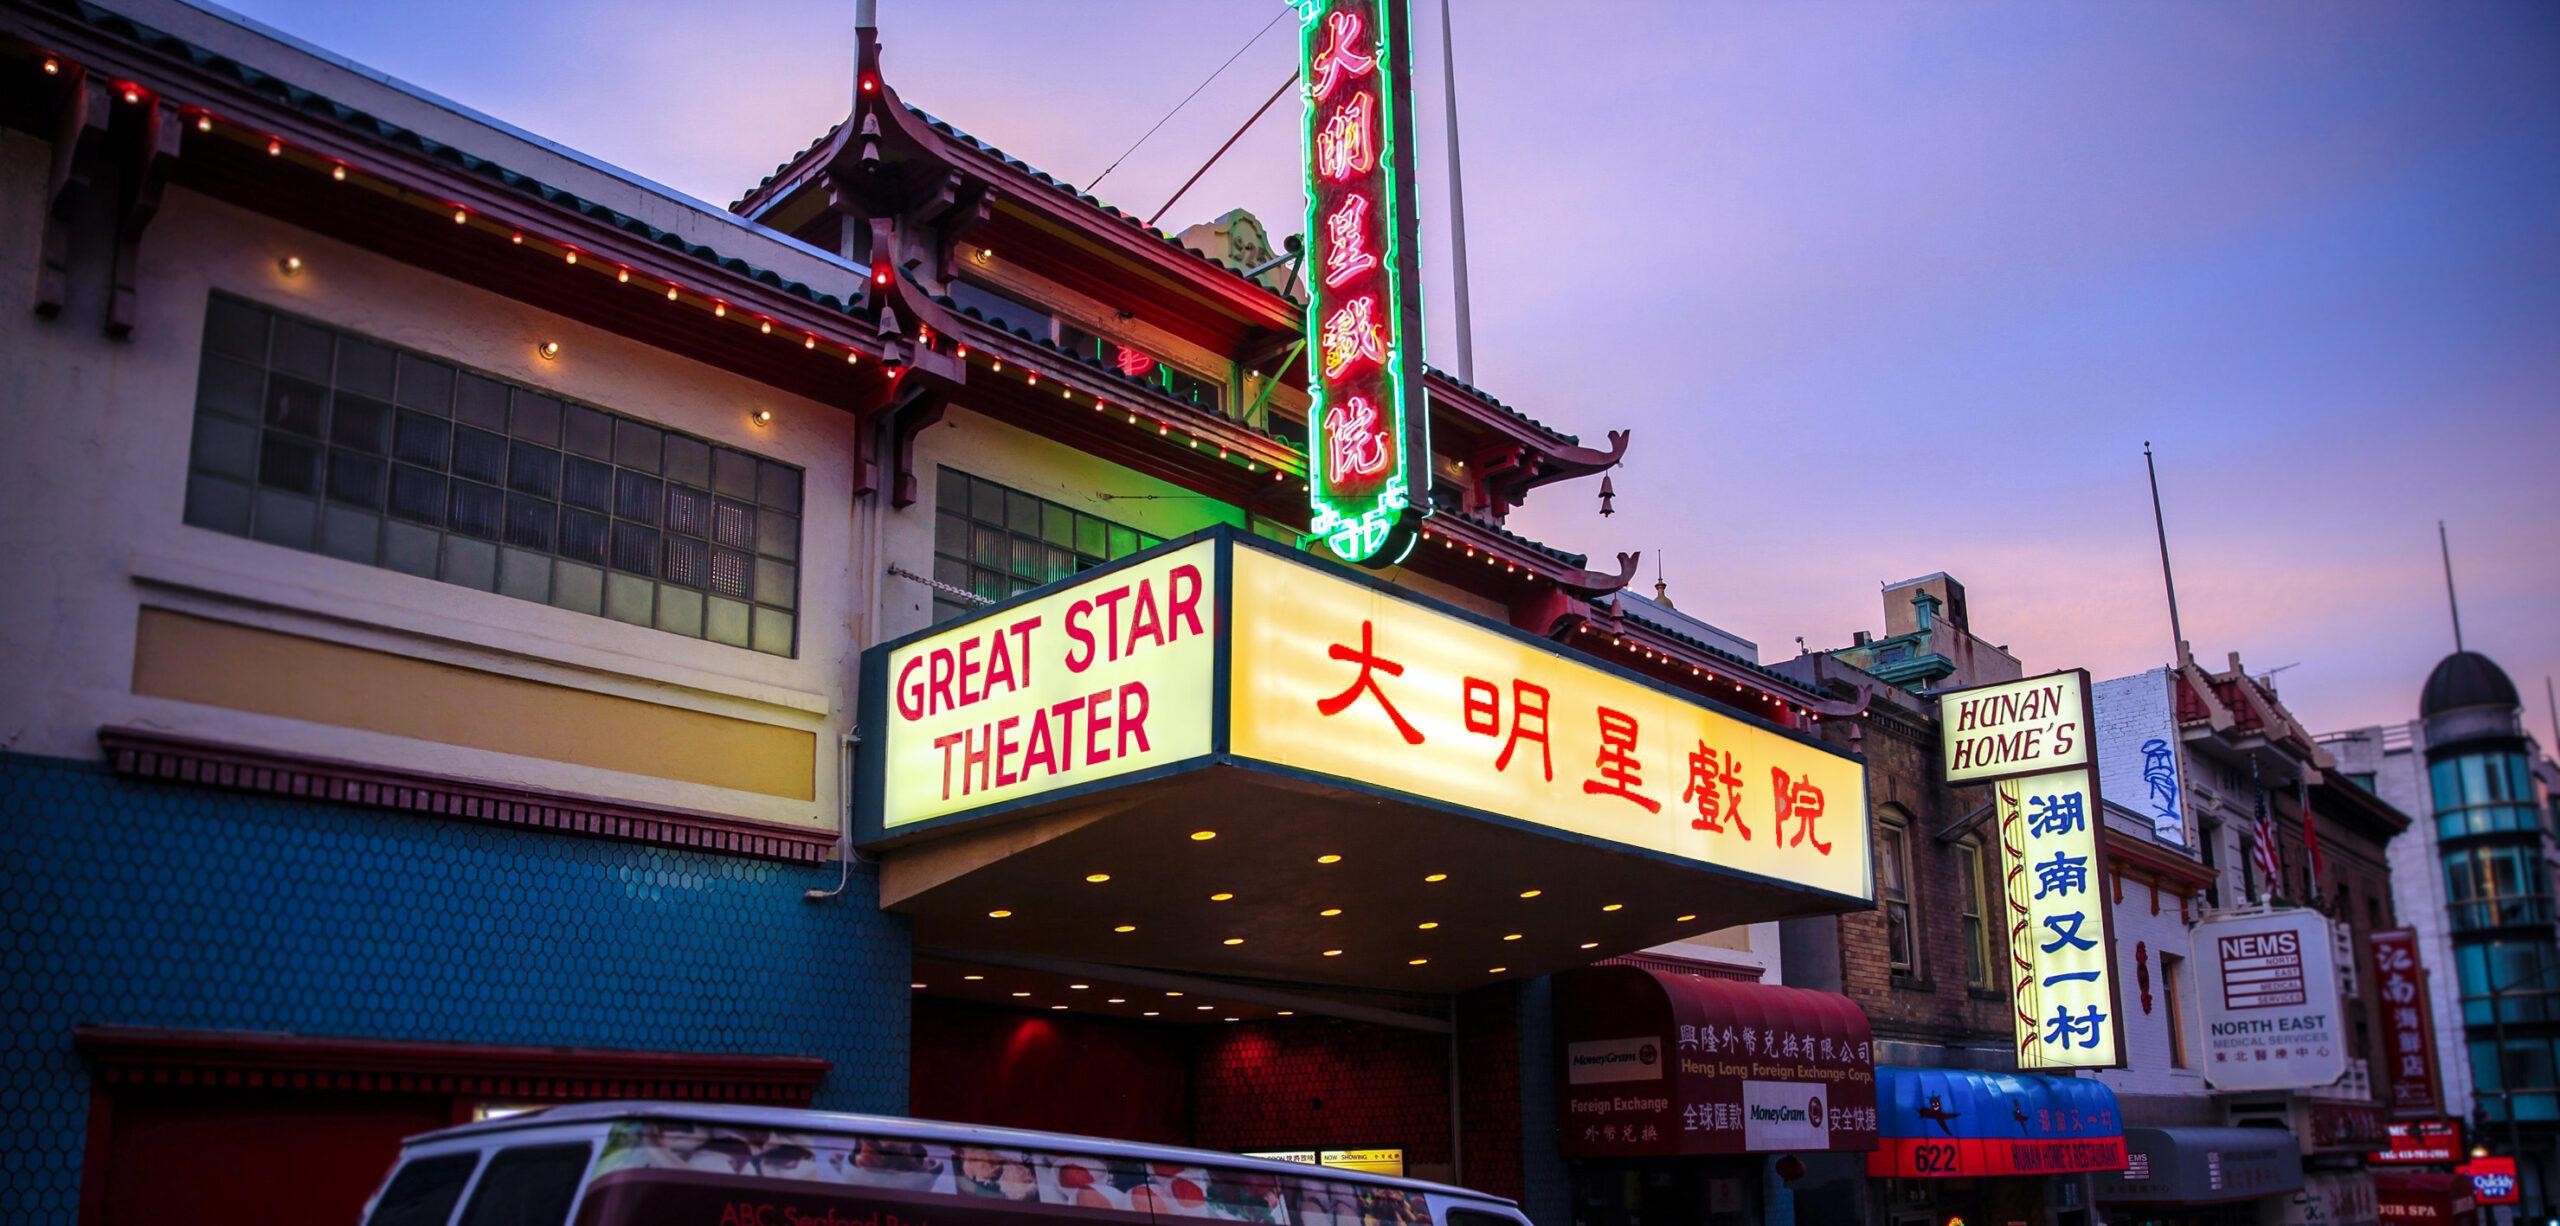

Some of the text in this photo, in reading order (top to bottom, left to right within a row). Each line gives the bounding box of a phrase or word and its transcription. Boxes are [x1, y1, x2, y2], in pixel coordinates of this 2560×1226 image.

[1312, 11, 1386, 484] 大明星戲院
[896, 563, 1205, 721] GREAT STAR
[1957, 685, 2063, 732] HUNAN
[933, 681, 1151, 801] THEATER
[1317, 619, 1832, 856] 大明星戲院
[1952, 722, 2076, 771] HOME'S
[2027, 791, 2108, 1051] 湖南又一村
[2221, 933, 2297, 959] NEMS
[2265, 955, 2298, 965] NORTH
[2274, 968, 2298, 977] EAST
[2211, 1015, 2326, 1036] NORTH EAST
[2213, 1032, 2329, 1048] MEDICAL SERVICES
[1573, 1052, 1636, 1066] MoneyGram
[1681, 1058, 1873, 1085] Heng Long Foreign Exchange Corp.
[1571, 1096, 1669, 1115] Foreign Exchange
[1683, 1103, 1744, 1131] 全球匯款
[1749, 1104, 1806, 1125] MoneyGram
[1829, 1105, 1877, 1132] 安全快捷
[1341, 1153, 1368, 1161] SHOWING
[1914, 1144, 1957, 1173] 622
[2011, 1144, 2041, 1171] HUNAN
[2073, 1143, 2120, 1169] RESTAURANT
[2474, 1173, 2514, 1191] Quickly
[720, 1203, 775, 1226] ABC
[2408, 1205, 2437, 1217] SPA
